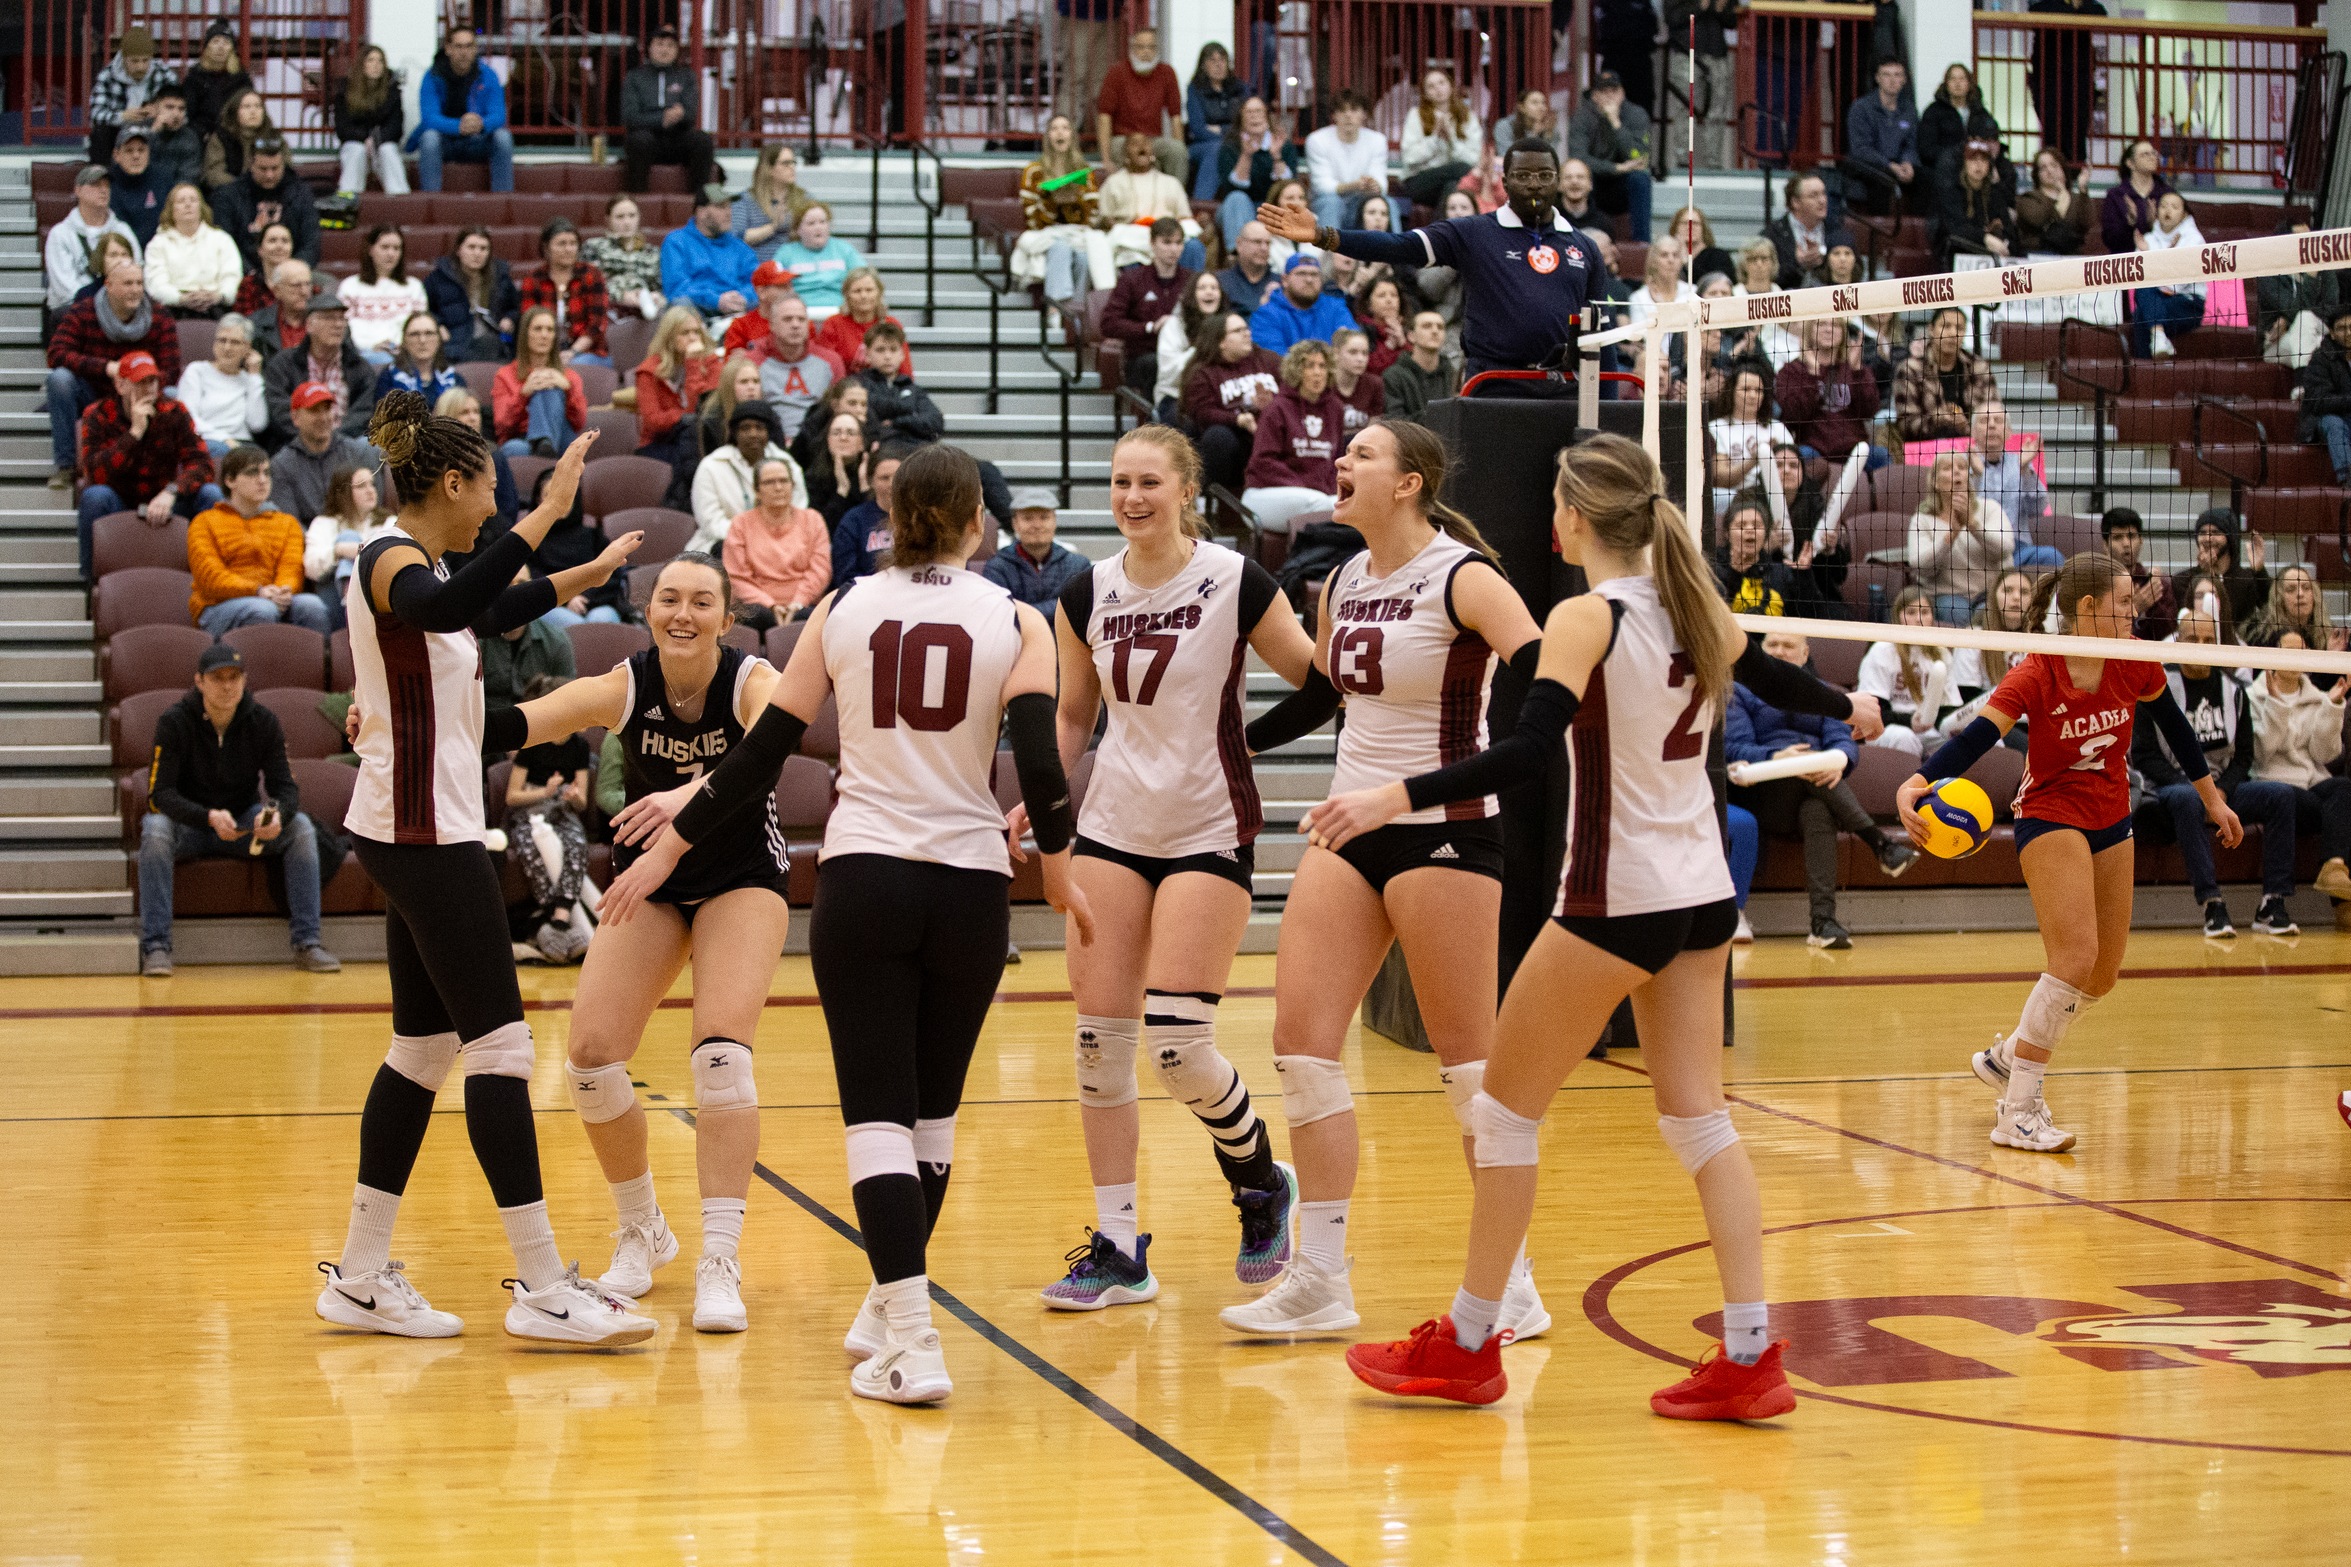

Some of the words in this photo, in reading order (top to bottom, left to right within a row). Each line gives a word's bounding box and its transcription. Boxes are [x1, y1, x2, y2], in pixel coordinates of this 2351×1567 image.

[1748, 295, 1792, 320] HUSKIES
[1902, 277, 1955, 305] HUSKIES
[2084, 255, 2145, 287] HUSKIES
[2299, 232, 2351, 265] HUSKI
[784, 367, 810, 396] A
[911, 567, 952, 586] SMU
[1103, 604, 1203, 641] HUSKIES
[869, 619, 974, 732] 10
[1112, 632, 1179, 706] 17
[1330, 626, 1385, 696] 13
[644, 712, 665, 722] adidas
[1662, 651, 1707, 762] 2
[2060, 707, 2130, 740] ACADIA
[641, 727, 728, 763] HUSKIES
[2068, 733, 2118, 770] 2
[1430, 851, 1460, 859] adidas
